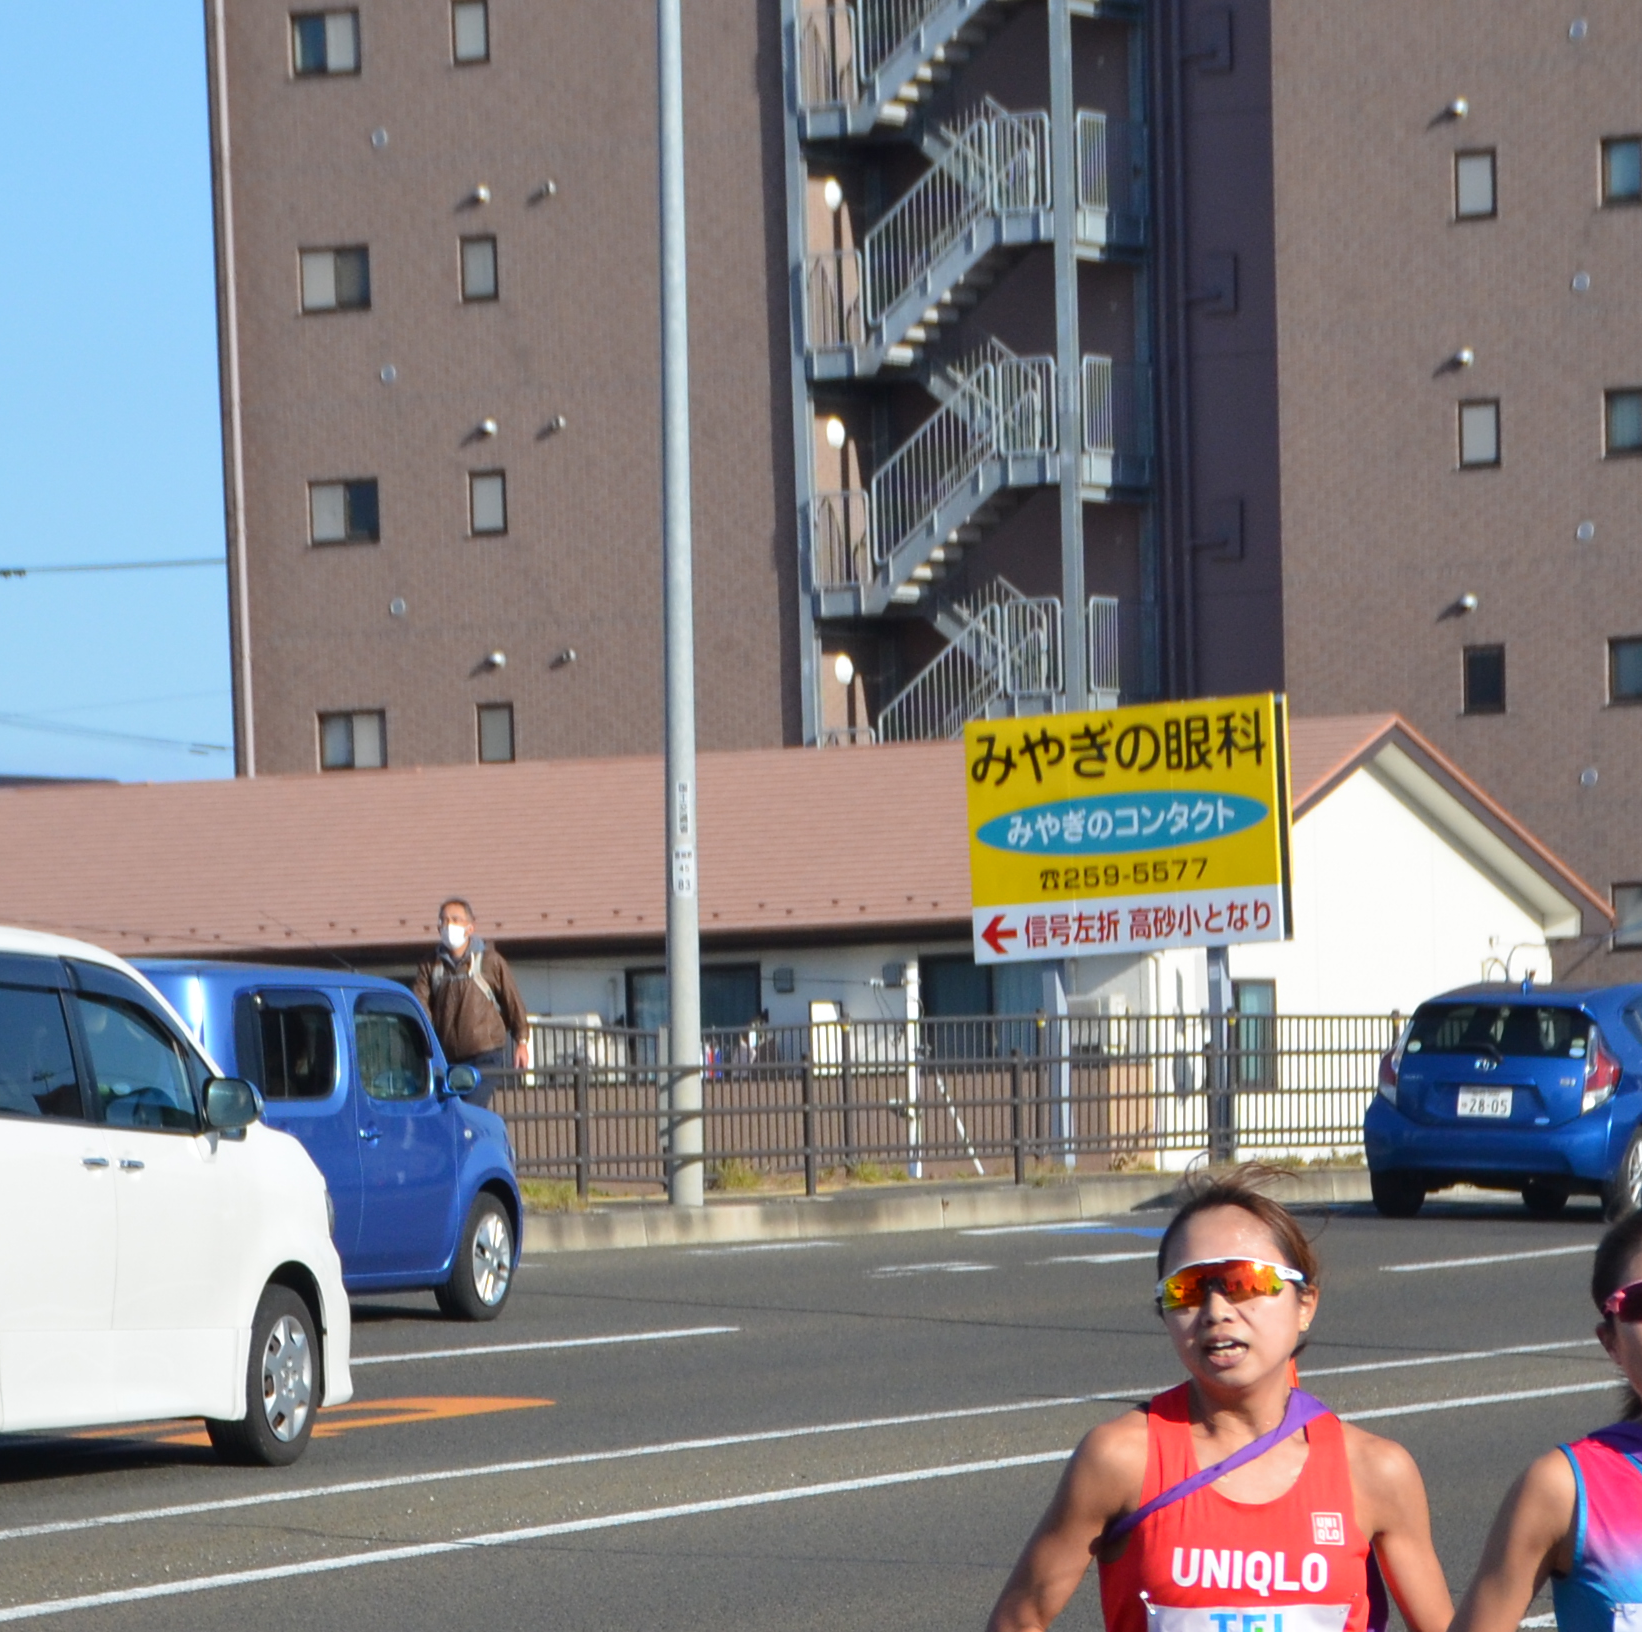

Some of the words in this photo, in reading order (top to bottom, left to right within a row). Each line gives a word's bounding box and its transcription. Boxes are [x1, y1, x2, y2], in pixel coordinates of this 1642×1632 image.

[970, 708, 1267, 786] みやぎの眼科
[1007, 798, 1235, 847] みやぎのコンタクト
[1063, 857, 1208, 890] 259-5577
[1023, 909, 1120, 948] 信号左折
[1127, 898, 1271, 943] 高砂小となり
[1316, 1516, 1339, 1529] UNI
[1317, 1528, 1341, 1541] QLO
[1171, 1546, 1328, 1597] UNIQLO
